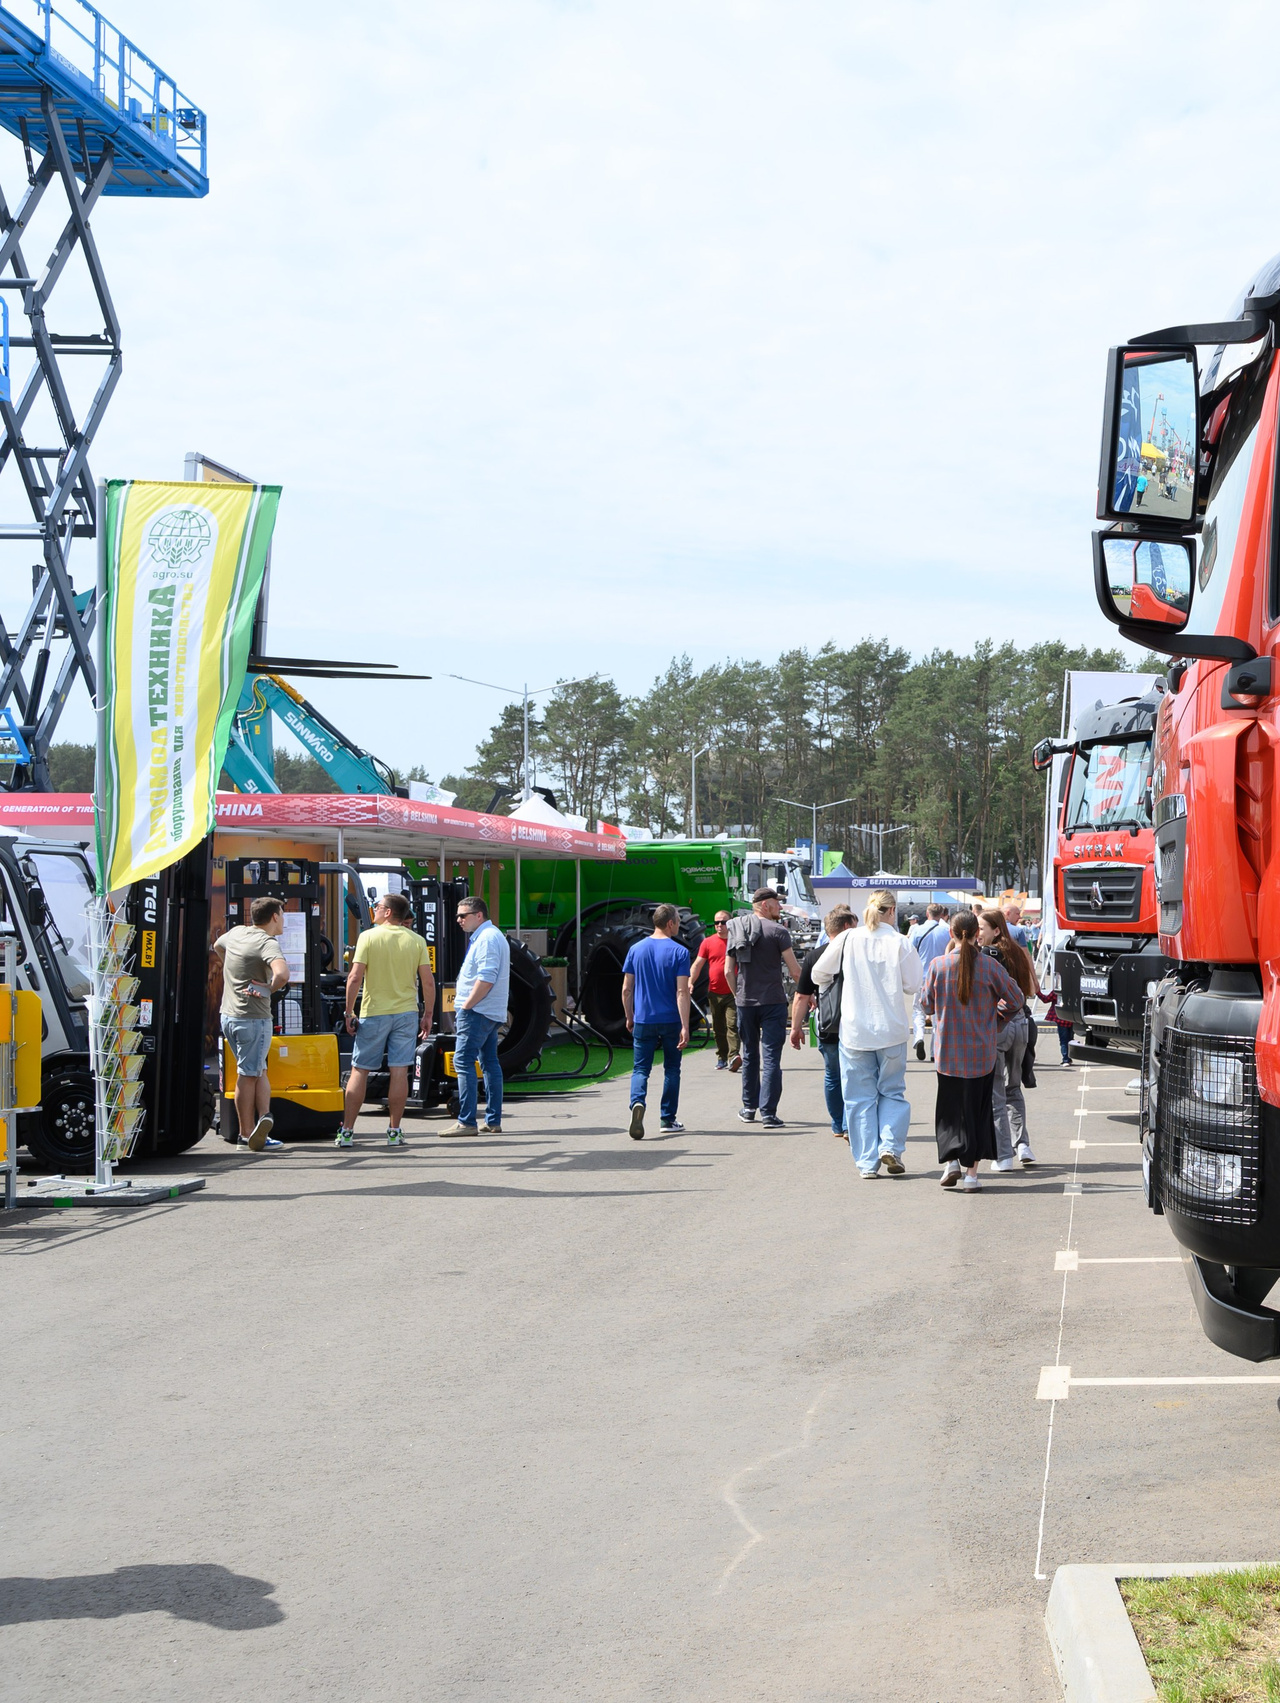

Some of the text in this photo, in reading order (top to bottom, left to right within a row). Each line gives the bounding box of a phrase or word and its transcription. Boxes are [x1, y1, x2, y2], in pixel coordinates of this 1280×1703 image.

[152, 571, 193, 580] agro.su
[174, 725, 184, 753] для
[284, 711, 334, 763] SUNWARD
[2, 805, 60, 813] GENERATION
[61, 805, 73, 813] OF
[75, 805, 95, 813] TIRE
[410, 810, 438, 825] BELSHINA
[518, 825, 547, 843] BELSHINA
[1073, 842, 1124, 859] SITRAK
[144, 885, 157, 924] TEU
[426, 913, 435, 942] TEU
[144, 932, 154, 966] VMX.BY
[1080, 977, 1107, 990] SITRAK
